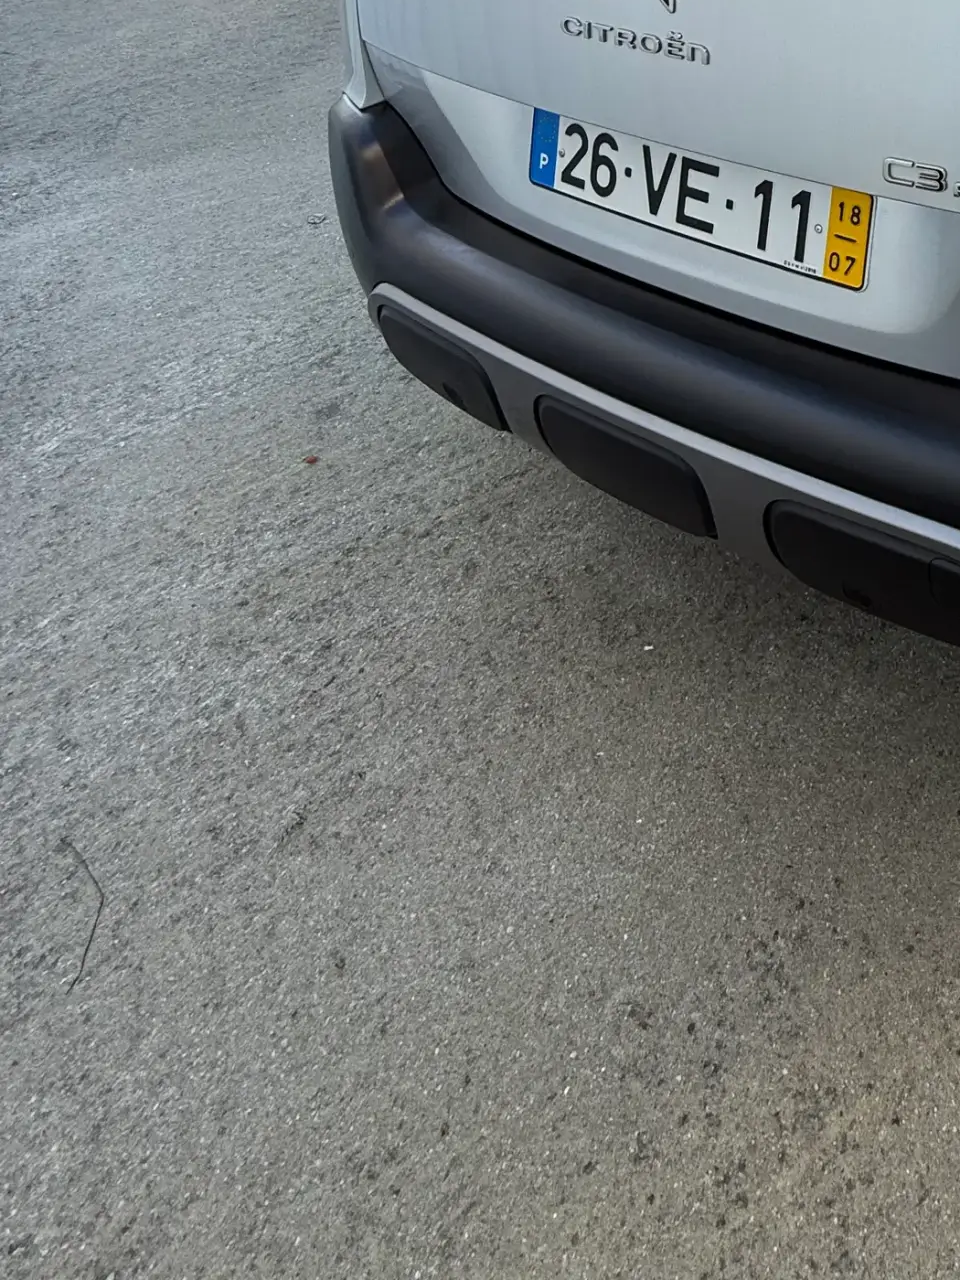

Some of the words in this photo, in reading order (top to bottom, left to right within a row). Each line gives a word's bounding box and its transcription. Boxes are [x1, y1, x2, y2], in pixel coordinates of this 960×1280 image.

[538, 152, 549, 170] P
[882, 156, 948, 193] C3
[838, 201, 862, 226] 18
[828, 251, 856, 276] 07
